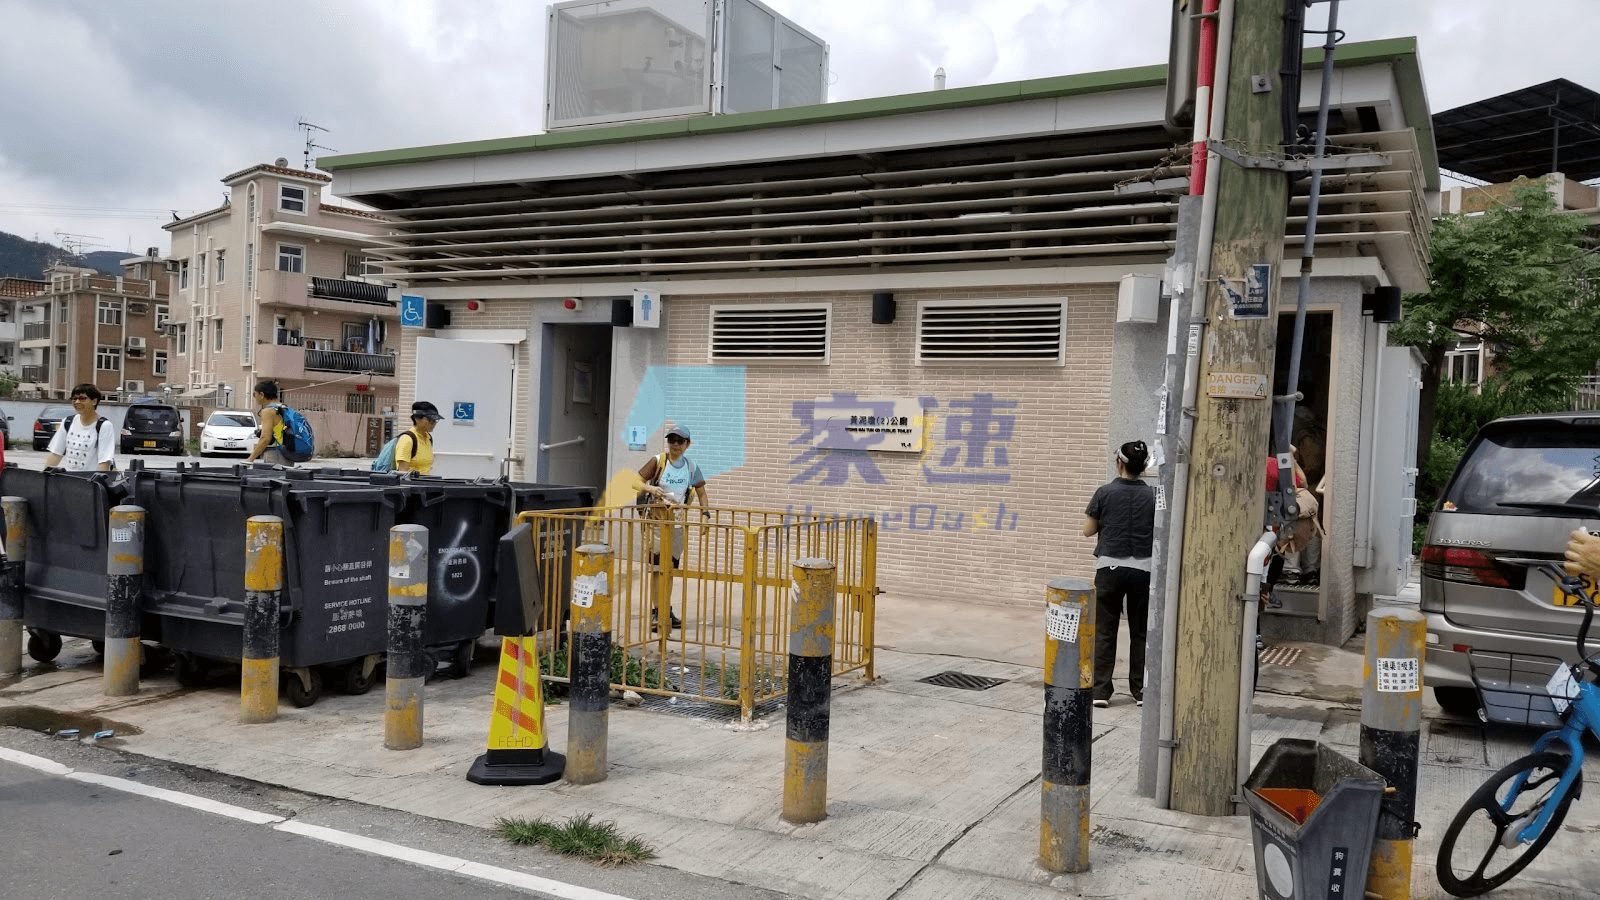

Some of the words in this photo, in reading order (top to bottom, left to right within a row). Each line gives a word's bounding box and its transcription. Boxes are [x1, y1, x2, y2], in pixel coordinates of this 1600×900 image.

[1210, 374, 1257, 385] DANGER
[324, 578, 343, 586] Beware
[359, 574, 372, 582] shaft
[324, 600, 348, 609] SERVICE
[348, 597, 372, 606] HOTLINE
[348, 620, 365, 631] 0000
[498, 735, 533, 748] FEHD
